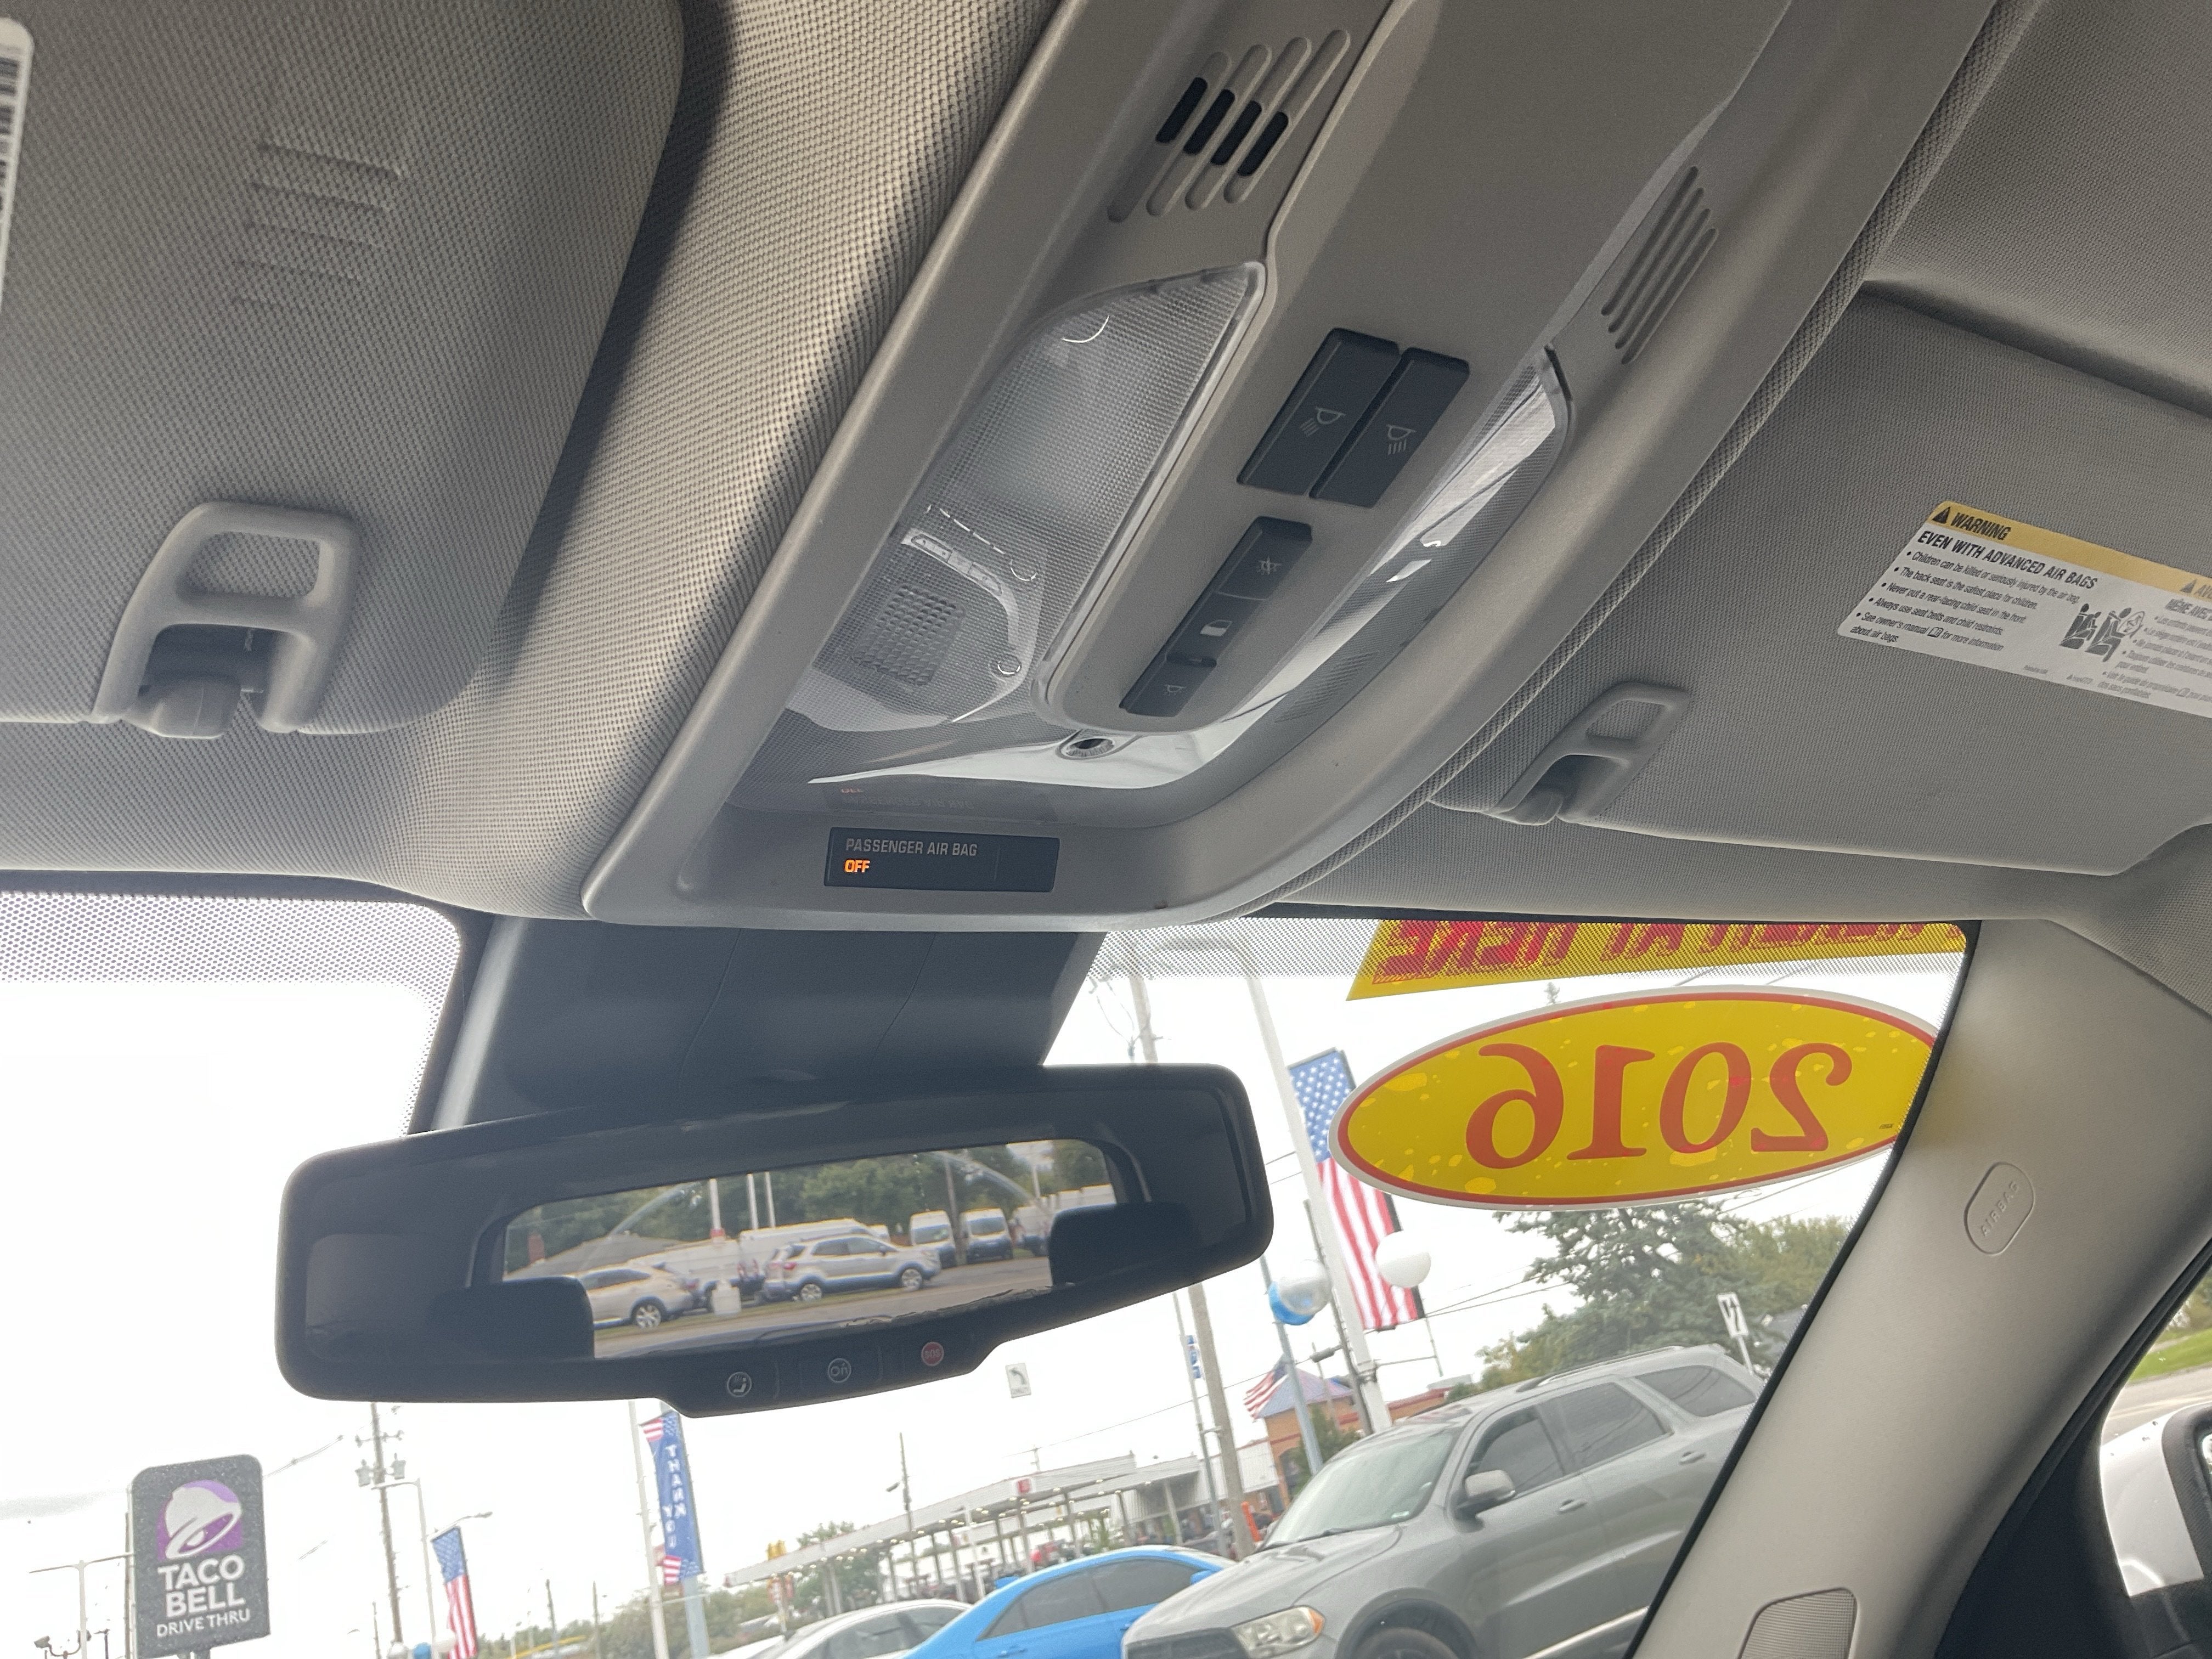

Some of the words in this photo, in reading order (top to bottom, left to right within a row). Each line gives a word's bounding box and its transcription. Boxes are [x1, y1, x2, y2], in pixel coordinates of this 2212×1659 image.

[1950, 512, 2011, 540] WARNING
[1911, 551, 1942, 566] Children
[1940, 560, 1955, 569] can
[1953, 563, 1965, 572] be
[1962, 565, 1983, 577] killed
[1988, 574, 2018, 588] seriously
[2016, 579, 2039, 592] injured
[2038, 585, 2048, 595] by
[2047, 588, 2059, 597] the
[1918, 531, 1953, 549] EVEN
[1951, 539, 1986, 558] WITH
[1982, 549, 2046, 574] ADVANCED
[2043, 566, 2067, 580] AIR
[2064, 572, 2098, 589] BAGS
[1886, 582, 1909, 594] Never
[1905, 589, 1922, 599] put
[1925, 593, 1961, 609] rear-facing
[1960, 601, 1979, 612] child
[1976, 606, 1994, 615] seat
[2000, 610, 2011, 620] the
[1900, 567, 1915, 578] The
[1915, 571, 1931, 583] back
[1929, 576, 1948, 586] seat
[1946, 579, 1954, 588] is
[1952, 580, 1965, 591] the
[1964, 585, 1987, 596] safest
[1982, 590, 2004, 600] place
[2002, 594, 2013, 602] for
[1874, 597, 1900, 611] Always
[1911, 607, 1929, 617] seat
[1926, 610, 1945, 621] belts
[1942, 615, 1959, 624] and
[1956, 617, 1976, 628] child
[1850, 625, 1873, 636] about
[1870, 629, 1882, 639] air
[1880, 631, 1899, 644] bags.
[1861, 612, 1876, 622] See
[1875, 617, 1904, 629] owner's
[1902, 623, 1930, 634] manual
[1941, 630, 1953, 639] for
[1951, 634, 1970, 644] more
[1968, 638, 2004, 651] information
[845, 838, 924, 855] PASSENGER
[927, 843, 949, 856] AIR
[952, 843, 978, 856] BAG
[844, 859, 871, 873] OFF
[1981, 1181, 2019, 1237] AIRBAG
[157, 1554, 245, 1591] TACO
[165, 1582, 245, 1617] BELL
[156, 1616, 205, 1638] DRIVE
[206, 1609, 250, 1628] THRU
